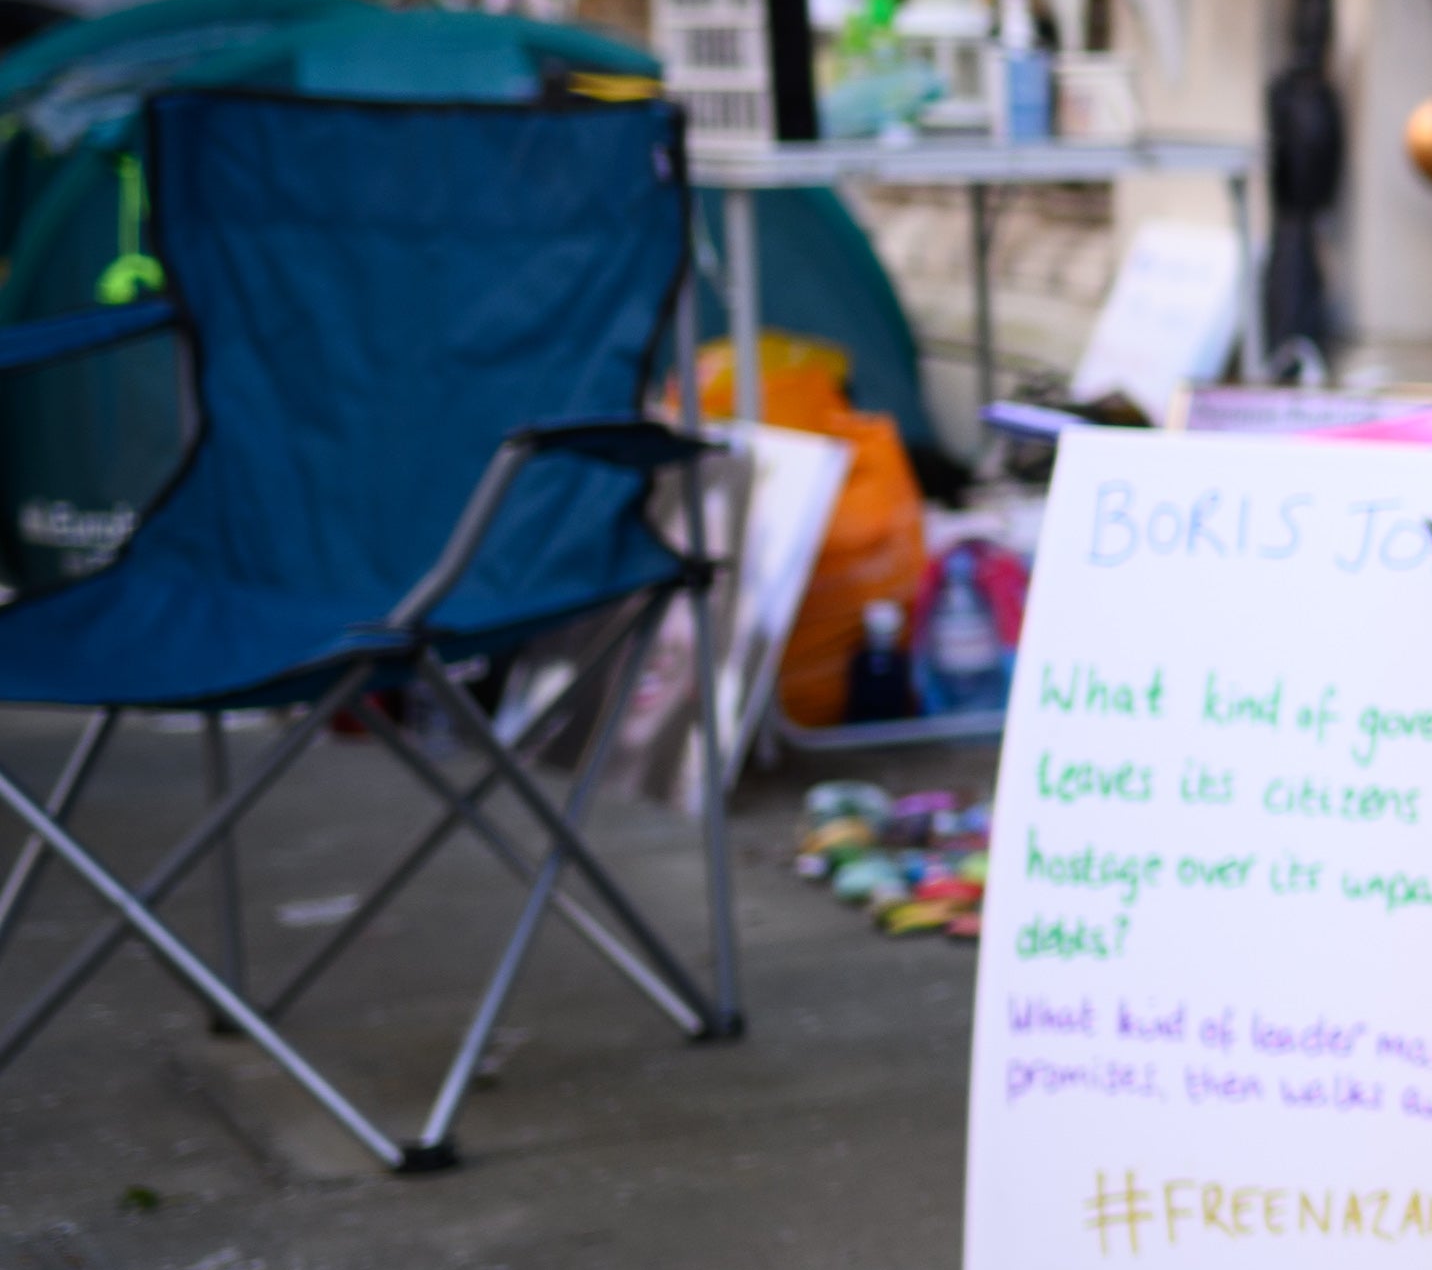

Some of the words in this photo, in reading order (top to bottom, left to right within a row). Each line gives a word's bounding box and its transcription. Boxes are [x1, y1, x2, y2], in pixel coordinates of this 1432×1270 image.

[1085, 479, 1316, 569] BORIS
[1037, 661, 1165, 717] What
[1201, 669, 1285, 728] kind
[1296, 683, 1339, 743] of
[1180, 758, 1234, 805] its
[1261, 775, 1421, 826] citizens
[1025, 824, 1163, 906] hostage
[1176, 852, 1256, 889] over
[1270, 852, 1325, 896] its
[1006, 993, 1097, 1036] What
[1117, 996, 1188, 1041] kind
[1199, 1005, 1239, 1056] of
[1184, 1061, 1265, 1105] then
[1279, 1074, 1384, 1112] walks
